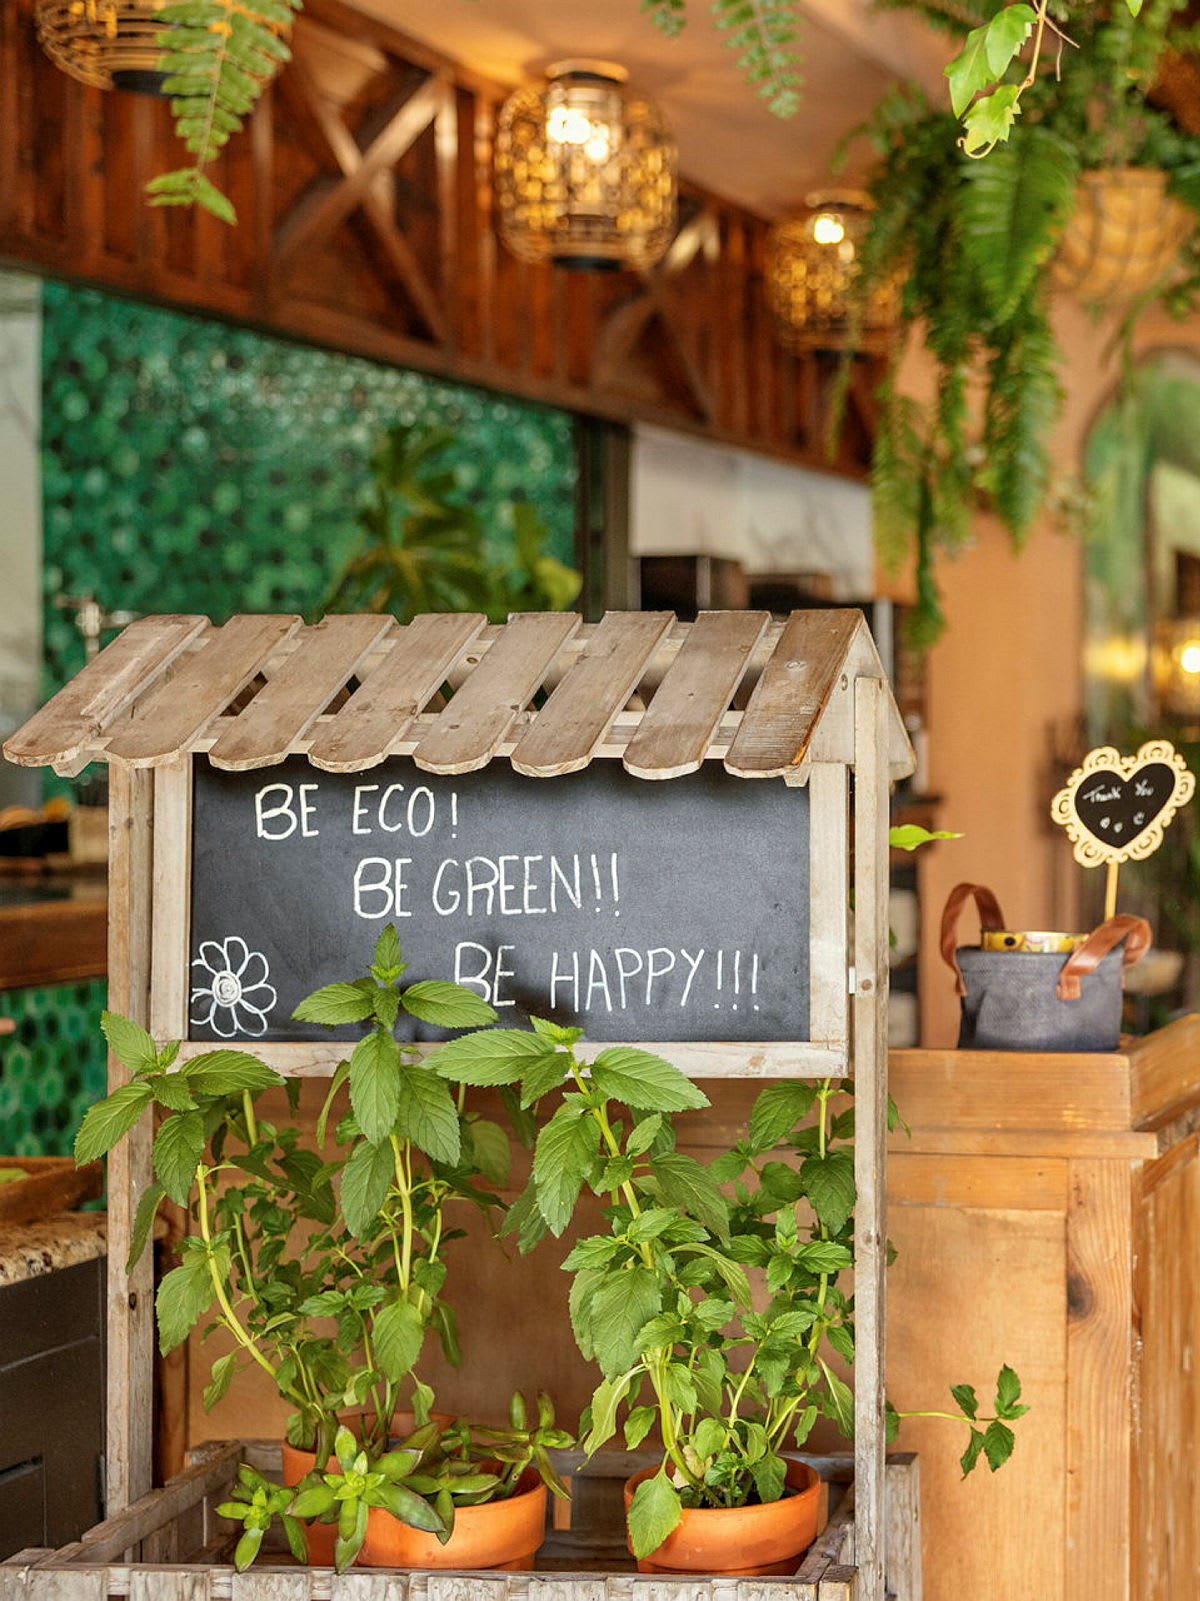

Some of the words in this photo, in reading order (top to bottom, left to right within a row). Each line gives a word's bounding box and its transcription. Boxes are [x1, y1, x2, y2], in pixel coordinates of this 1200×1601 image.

[255, 783, 319, 840] BE
[353, 784, 458, 838] ECO!
[353, 857, 412, 919] BE
[432, 853, 621, 917] GREEN!!
[453, 941, 516, 1007] BE
[550, 948, 760, 1013] HAPPY!!!
